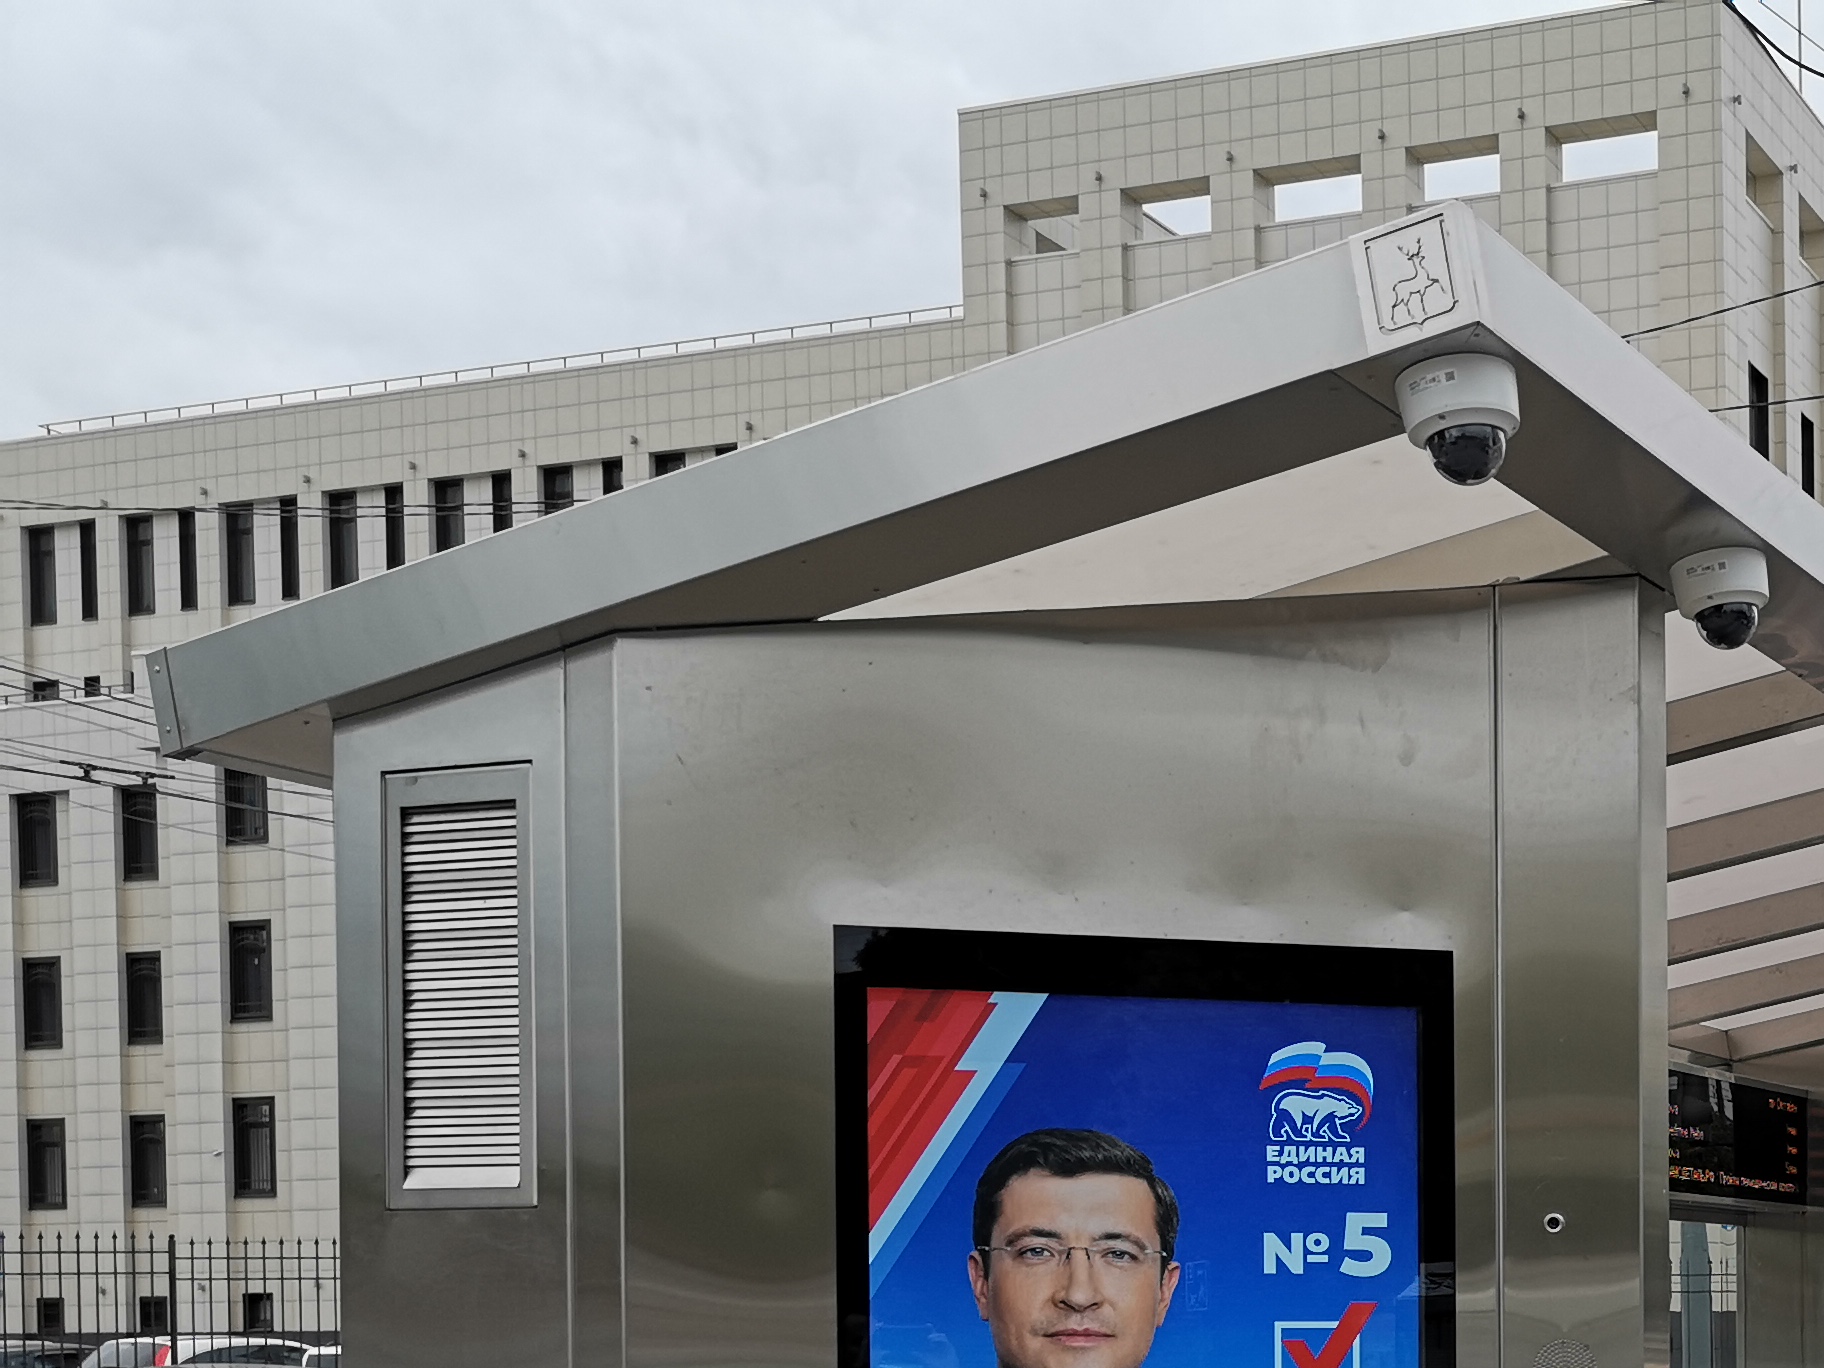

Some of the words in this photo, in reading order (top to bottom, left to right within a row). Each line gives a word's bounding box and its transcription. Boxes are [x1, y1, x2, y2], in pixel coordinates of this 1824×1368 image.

[1266, 1145, 1365, 1164] ЕДИНАЯ
[1267, 1165, 1366, 1185] РОССИЯ
[1339, 1212, 1392, 1277] 5
